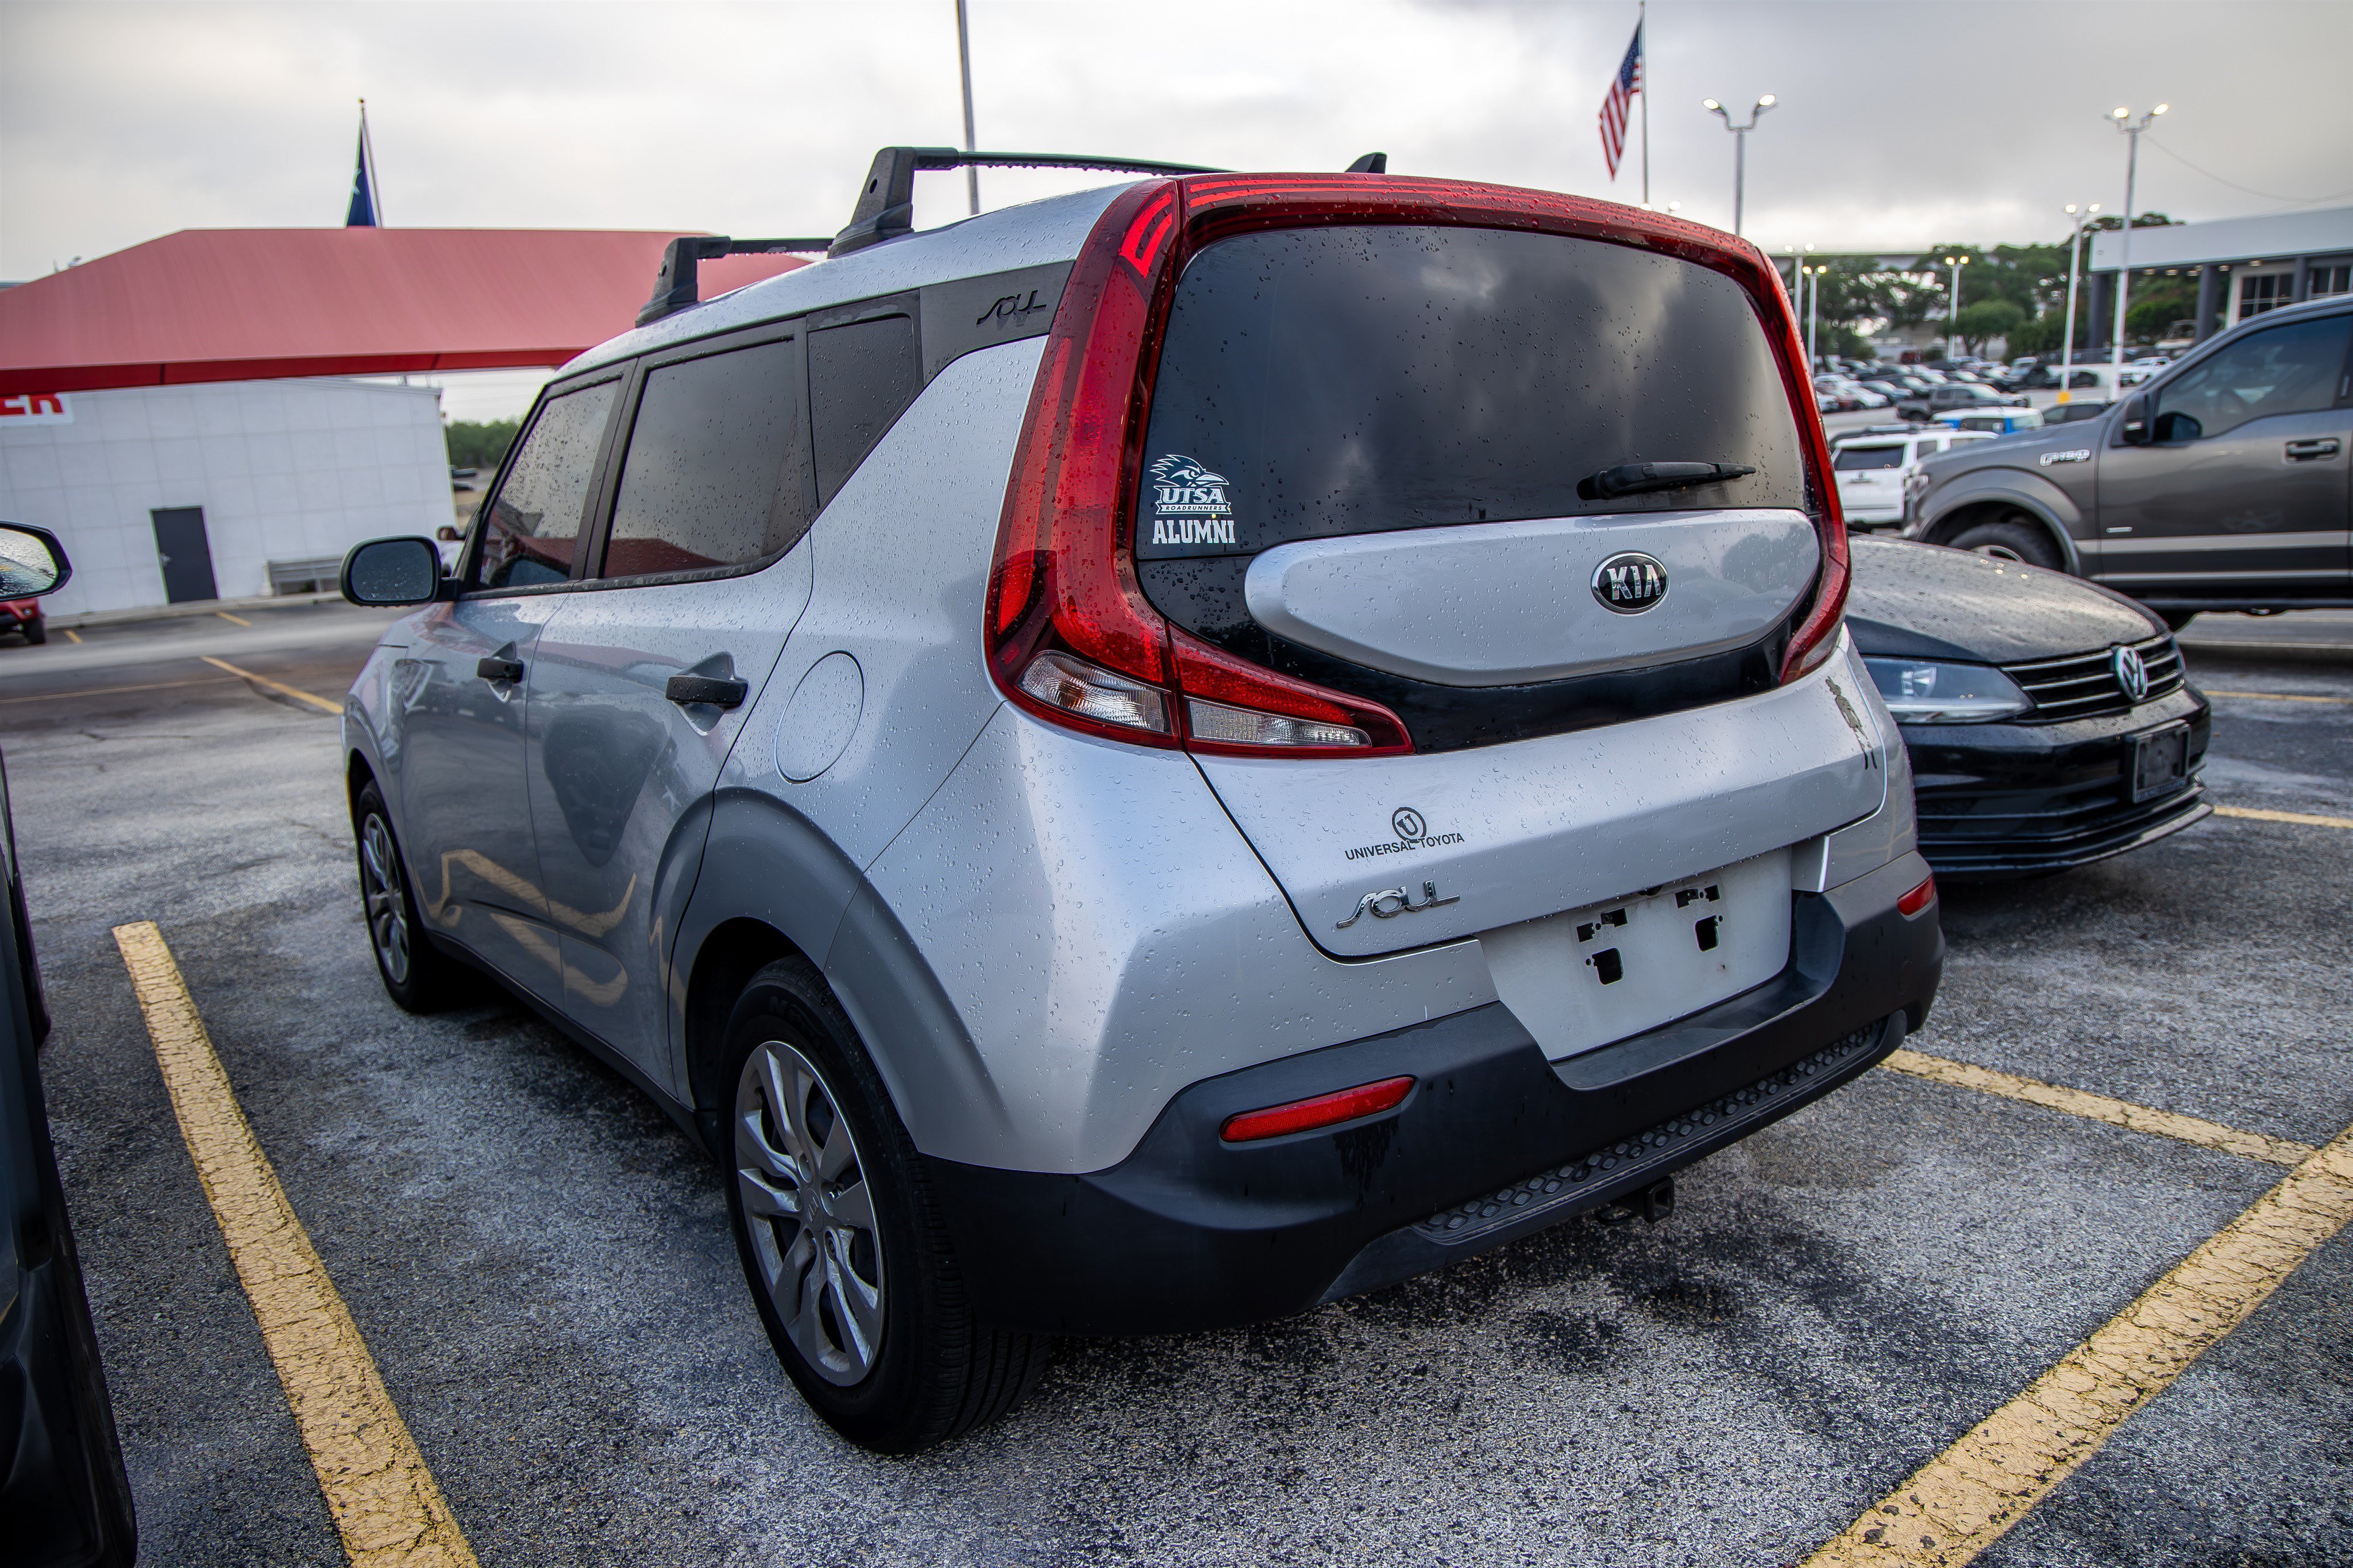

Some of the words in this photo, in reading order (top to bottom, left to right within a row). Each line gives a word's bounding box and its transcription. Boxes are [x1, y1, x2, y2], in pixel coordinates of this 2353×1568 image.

[1163, 488, 1224, 504] UTSA
[1152, 520, 1236, 544] ALUMNI
[1607, 564, 1662, 600] KIA
[1345, 840, 1416, 860] UNIVERSAL
[1418, 832, 1465, 848] TOYOTA
